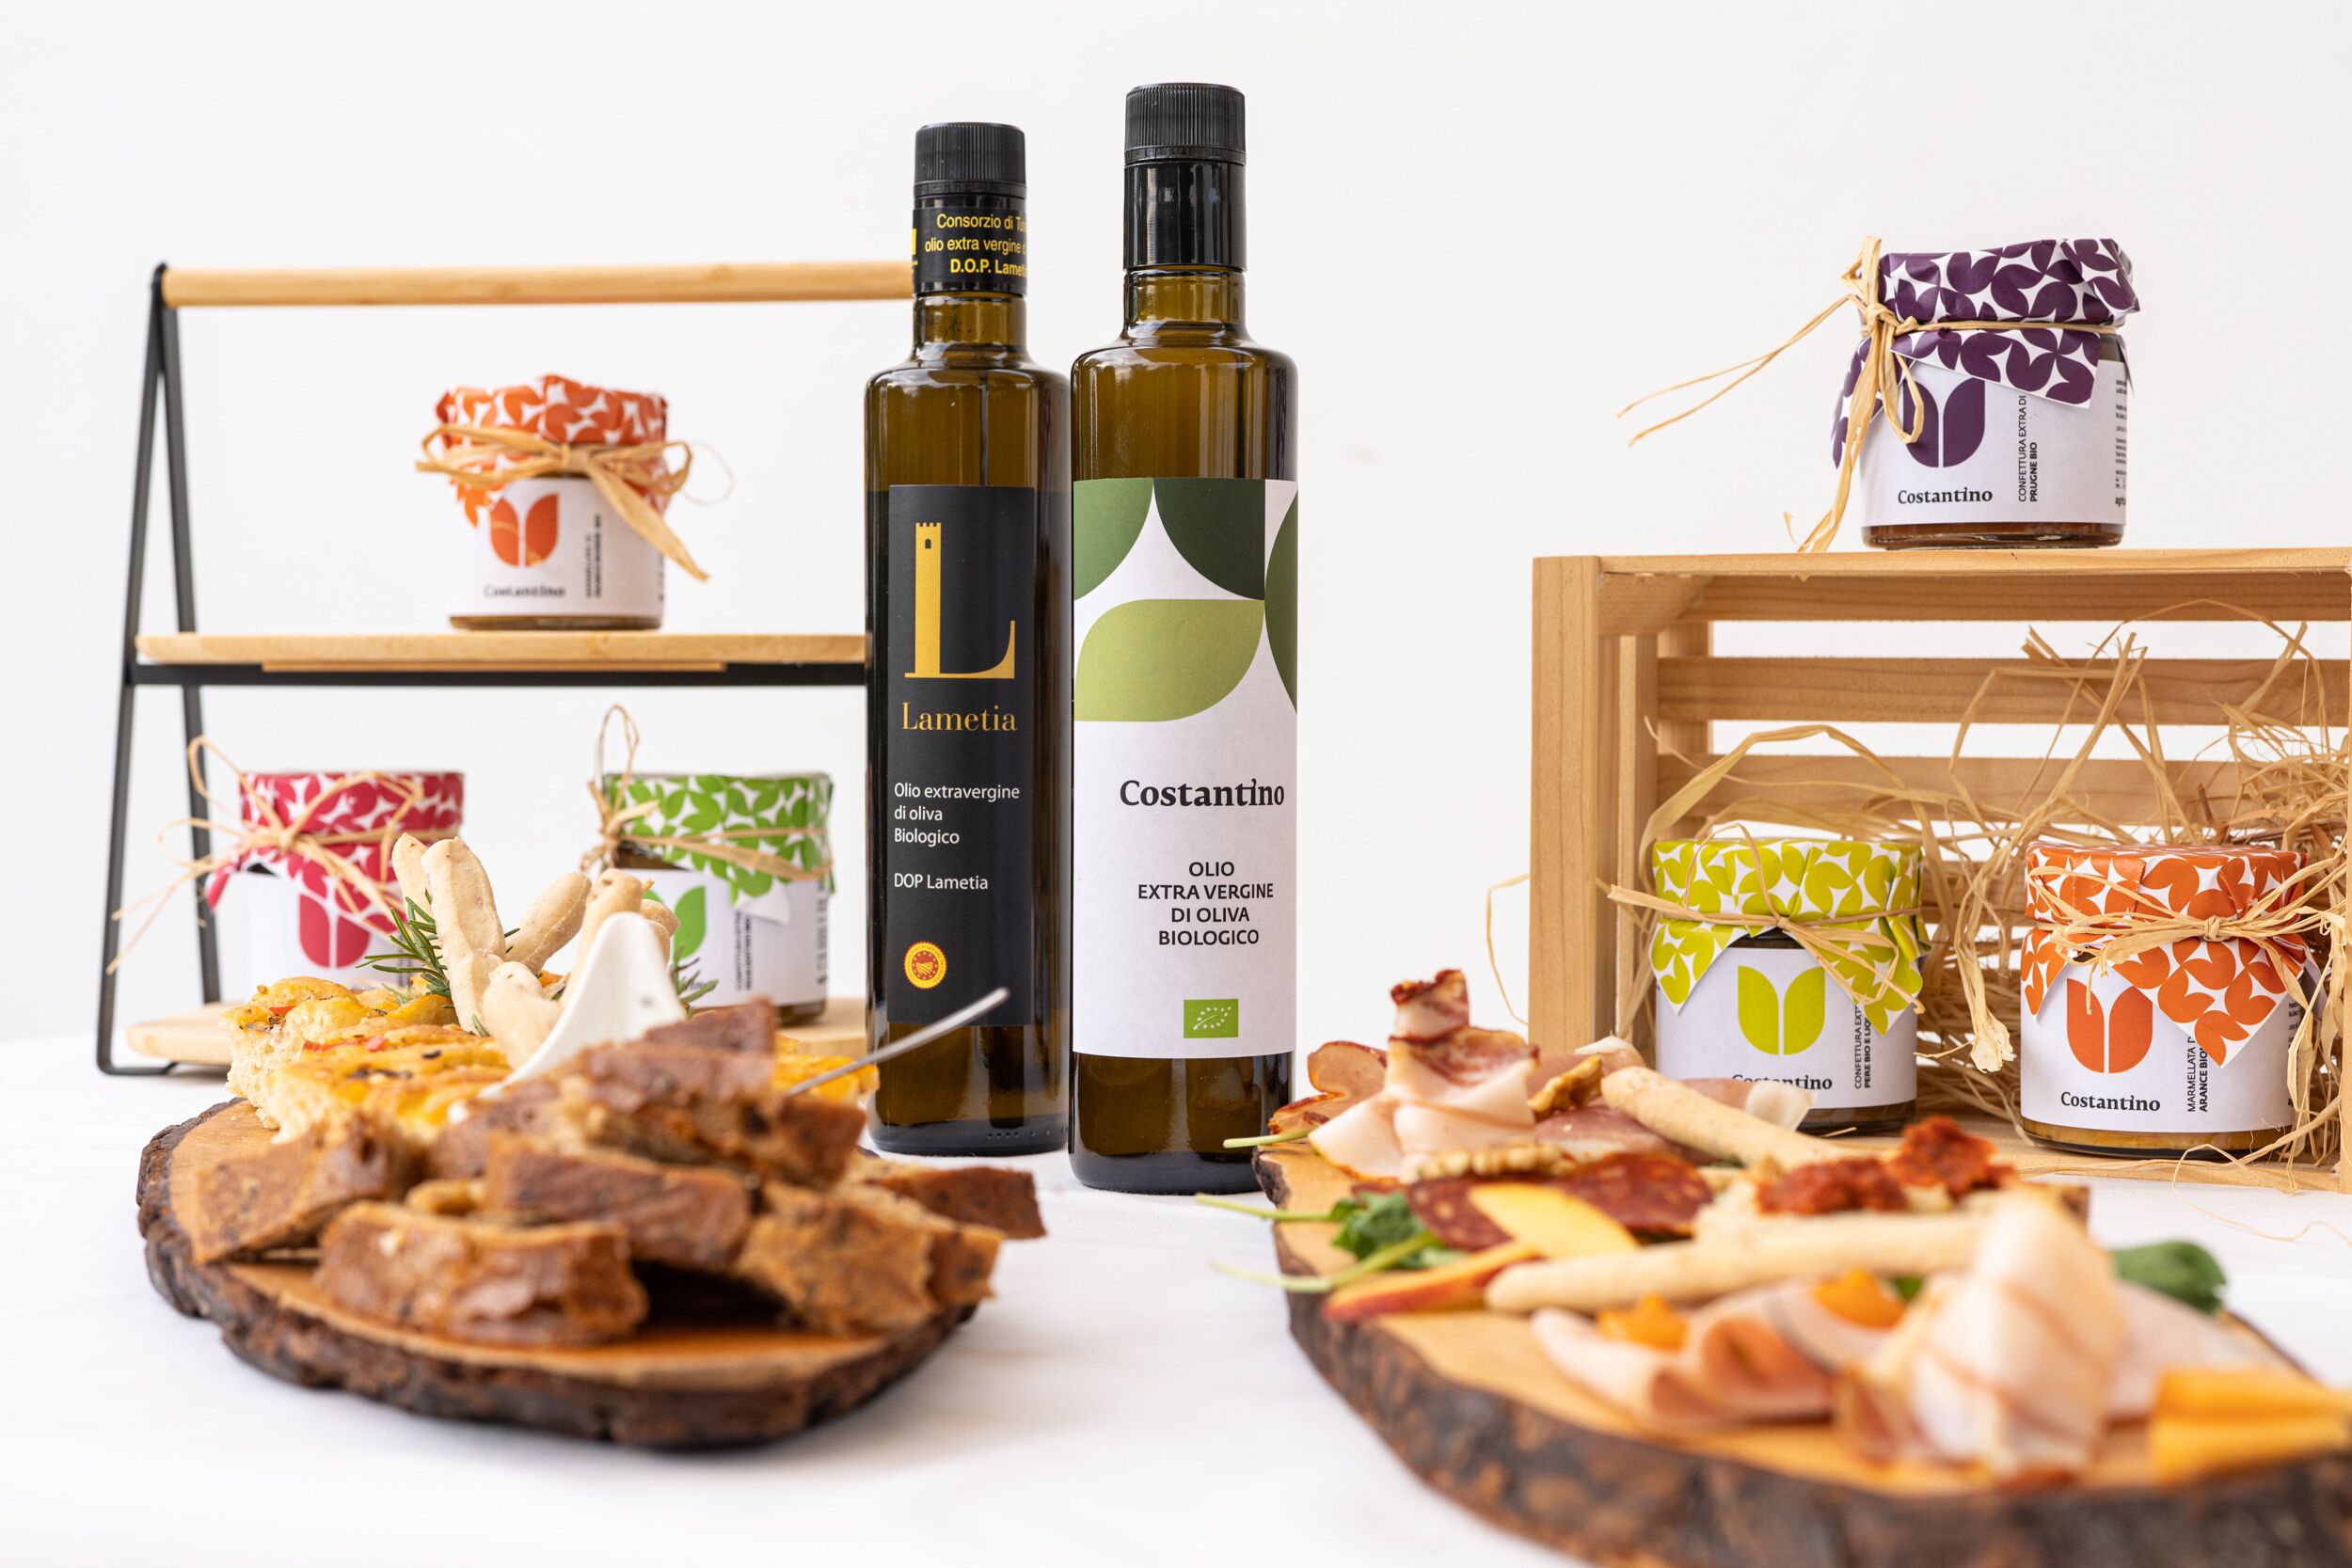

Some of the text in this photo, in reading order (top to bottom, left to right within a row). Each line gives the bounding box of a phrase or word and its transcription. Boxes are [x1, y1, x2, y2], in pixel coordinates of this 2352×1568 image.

[937, 214, 1001, 229] Consorzio
[1004, 215, 1013, 230] di
[925, 237, 944, 252] olio
[947, 237, 980, 251] extra
[983, 238, 1022, 256] vergine
[950, 259, 1026, 277] D.O.P. Lamet
[2018, 395, 2026, 502] CONFETTURA EXTRA DI
[2029, 442, 2038, 502] PRUGNE BIO
[1898, 487, 1993, 504] Costantino
[901, 702, 1018, 731] Lametia
[895, 783, 1020, 802] Olio extravergine
[1120, 779, 1284, 806] Costantino
[895, 805, 943, 821] di oliva
[895, 828, 960, 847] Biologico
[1188, 862, 1234, 877] OLIO
[894, 873, 988, 890] DOP Lametia
[1138, 883, 1274, 899] EXTRA VERGINE
[1171, 907, 1249, 923] DI OLIVA
[1159, 929, 1259, 945] BIOLOGICO
[2187, 1047, 2196, 1112] MARMELLATA
[2200, 1070, 2208, 1113] ARANCE
[2060, 1092, 2161, 1112] Costantino
